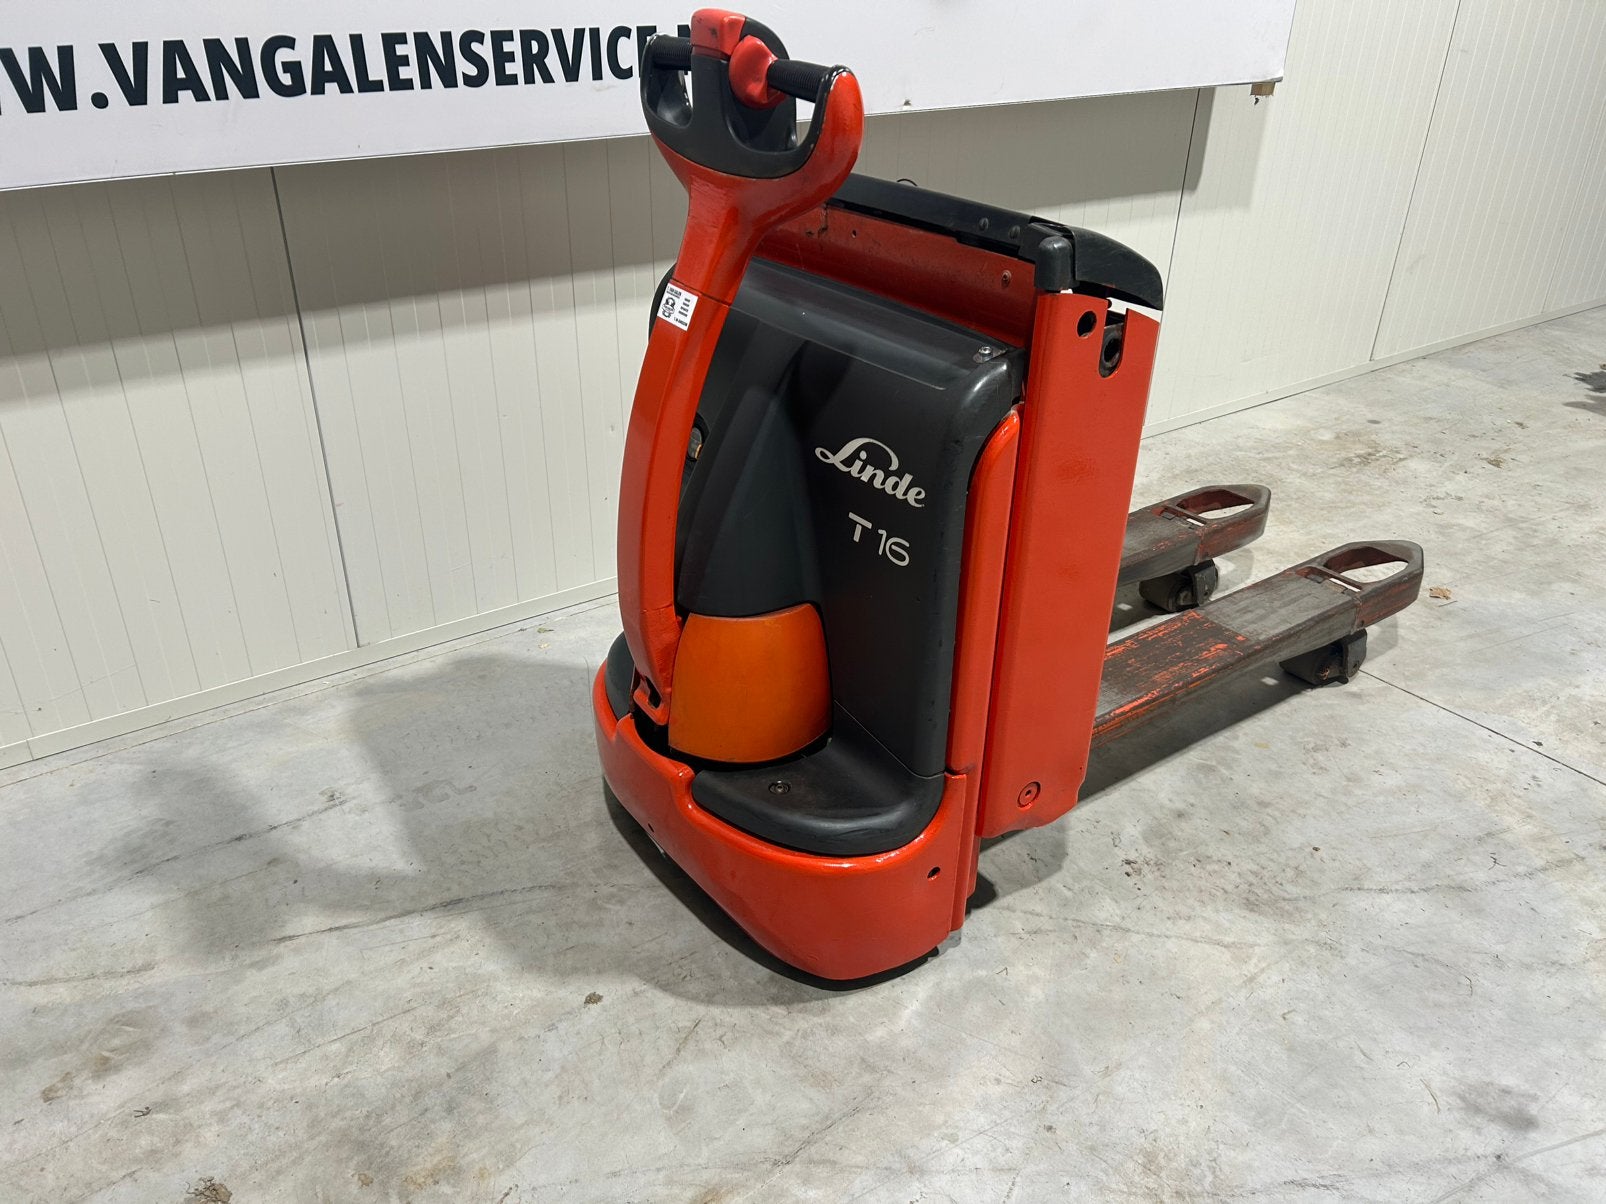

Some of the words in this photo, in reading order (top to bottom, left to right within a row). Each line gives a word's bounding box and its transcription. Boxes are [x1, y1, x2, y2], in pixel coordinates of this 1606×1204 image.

[0, 24, 691, 114] W.VANGALENSERVIC
[814, 437, 926, 508] Linde
[848, 511, 873, 543] T
[877, 529, 910, 567] 16
